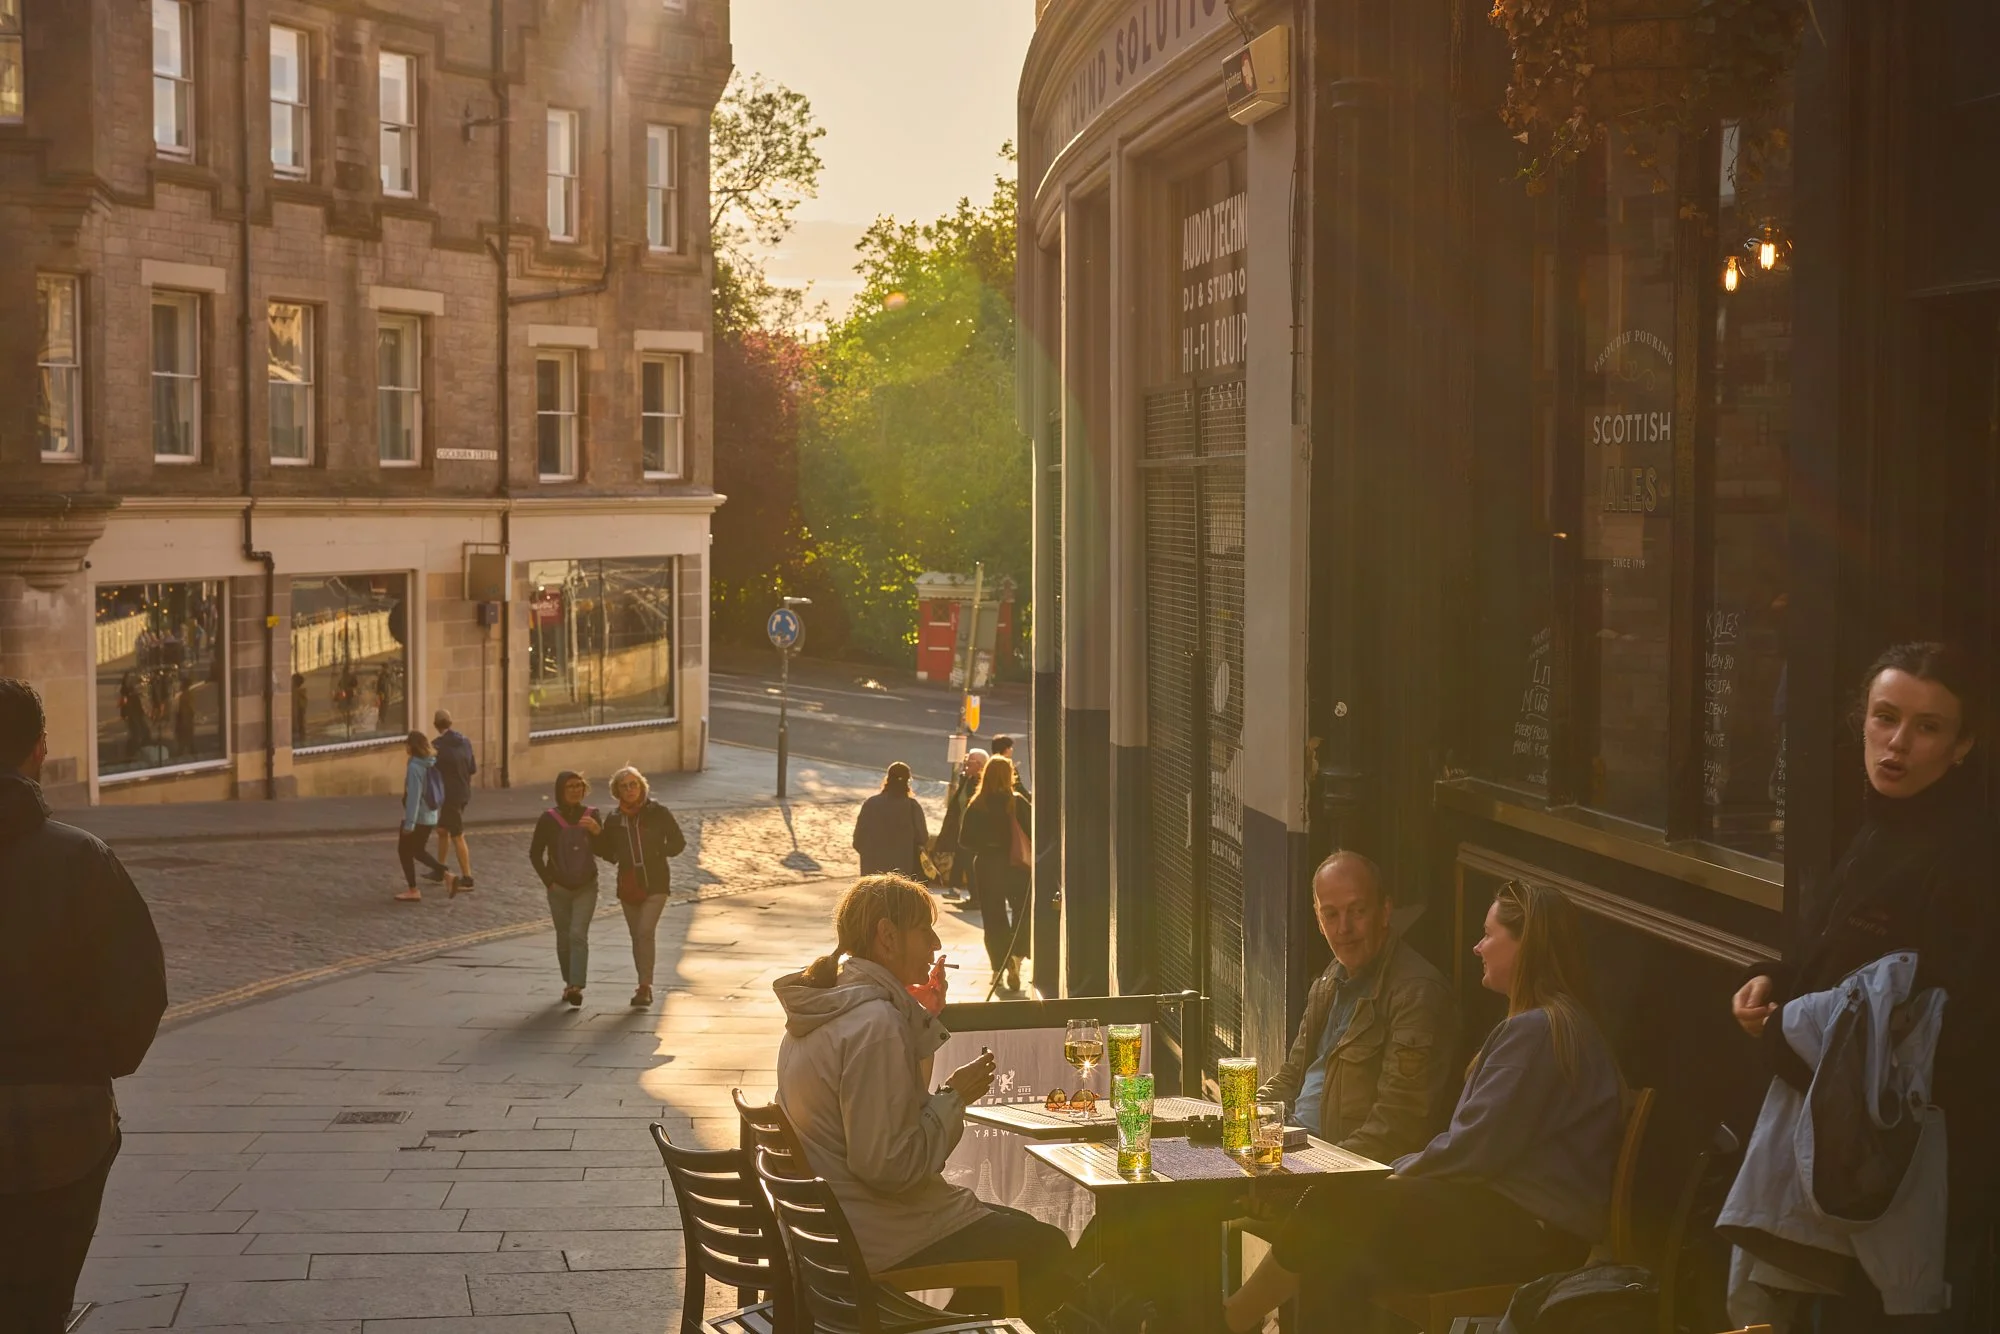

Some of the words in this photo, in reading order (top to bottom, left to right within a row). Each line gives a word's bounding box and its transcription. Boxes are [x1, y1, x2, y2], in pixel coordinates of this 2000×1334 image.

[1182, 207, 1212, 272] AUDIO
[1183, 284, 1194, 312] DJ
[1197, 282, 1204, 307] &
[1207, 267, 1246, 305] STUDIO
[1183, 322, 1209, 374] HI-FI
[1593, 330, 1632, 374] PROUDLY
[1634, 329, 1674, 366] POURING
[1593, 411, 1671, 444] SCOTTISH
[1603, 466, 1657, 512] ALES
[1612, 558, 1631, 568] SINCE
